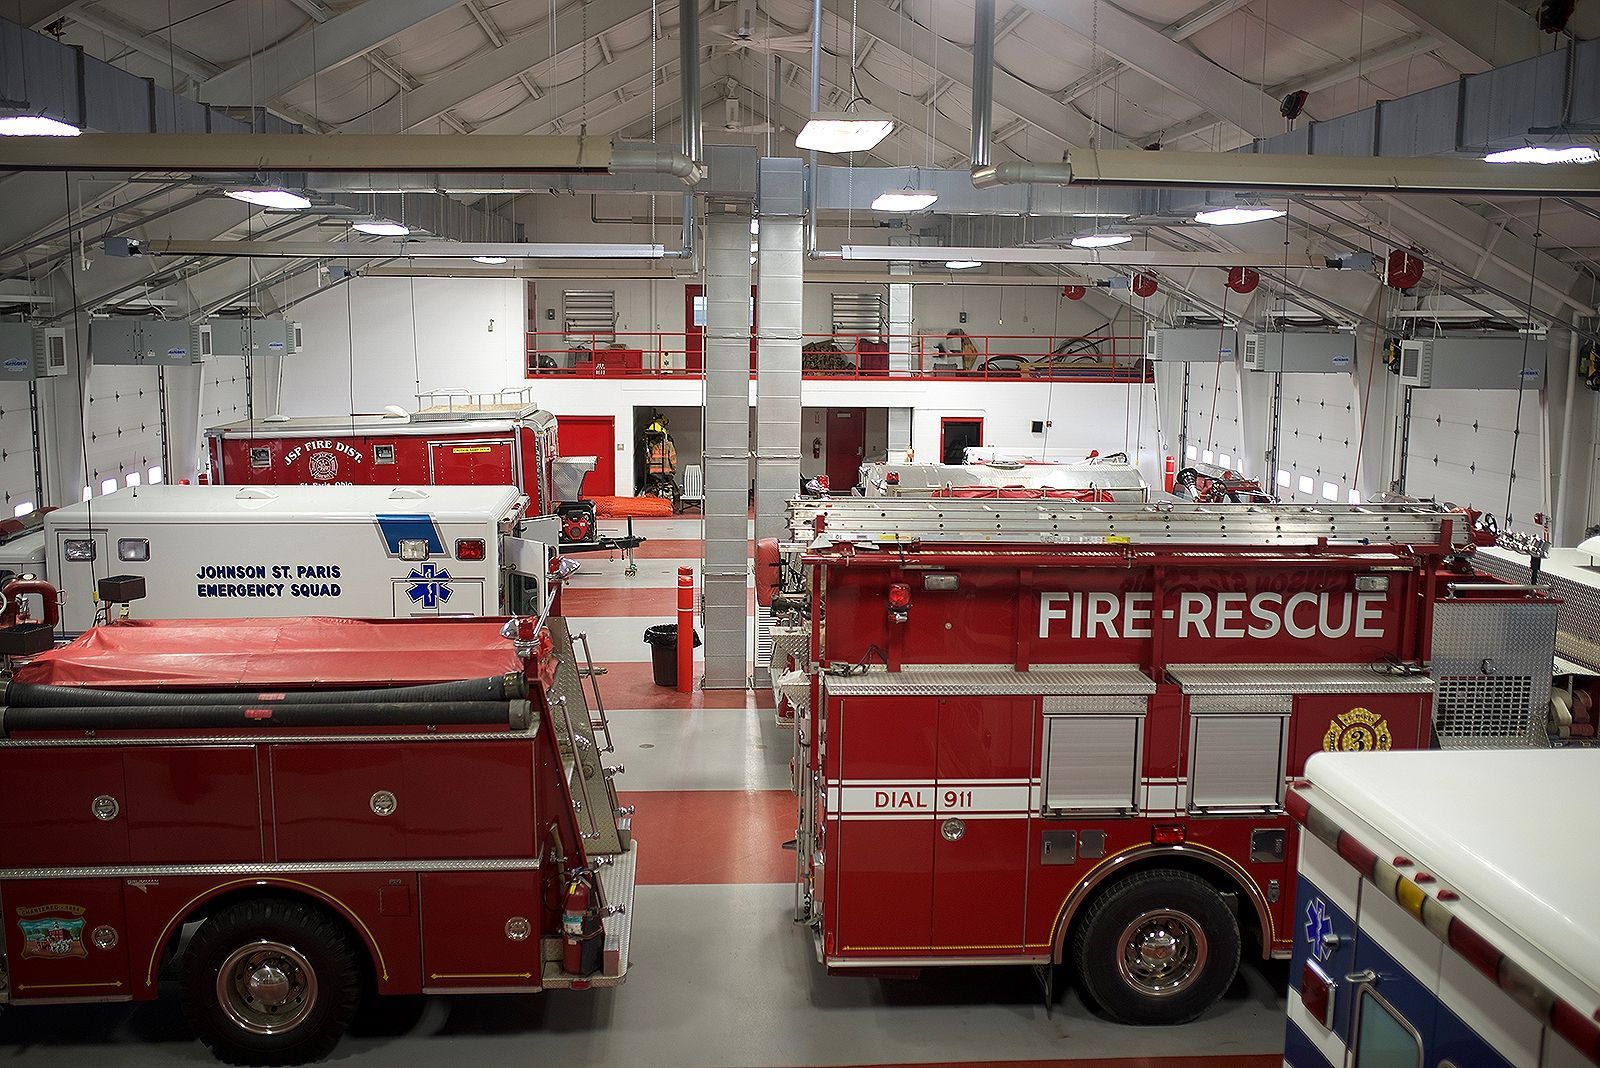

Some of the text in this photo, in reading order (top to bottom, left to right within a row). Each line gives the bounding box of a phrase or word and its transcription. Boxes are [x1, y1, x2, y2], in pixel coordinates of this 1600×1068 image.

[284, 440, 363, 466] JSP FIRE DIST.
[196, 565, 341, 579] JOHNSON ST. PARIS
[197, 584, 341, 598] EMERGENCY SQUAD
[1349, 730, 1365, 752] 3
[875, 790, 972, 808] DIAL 911
